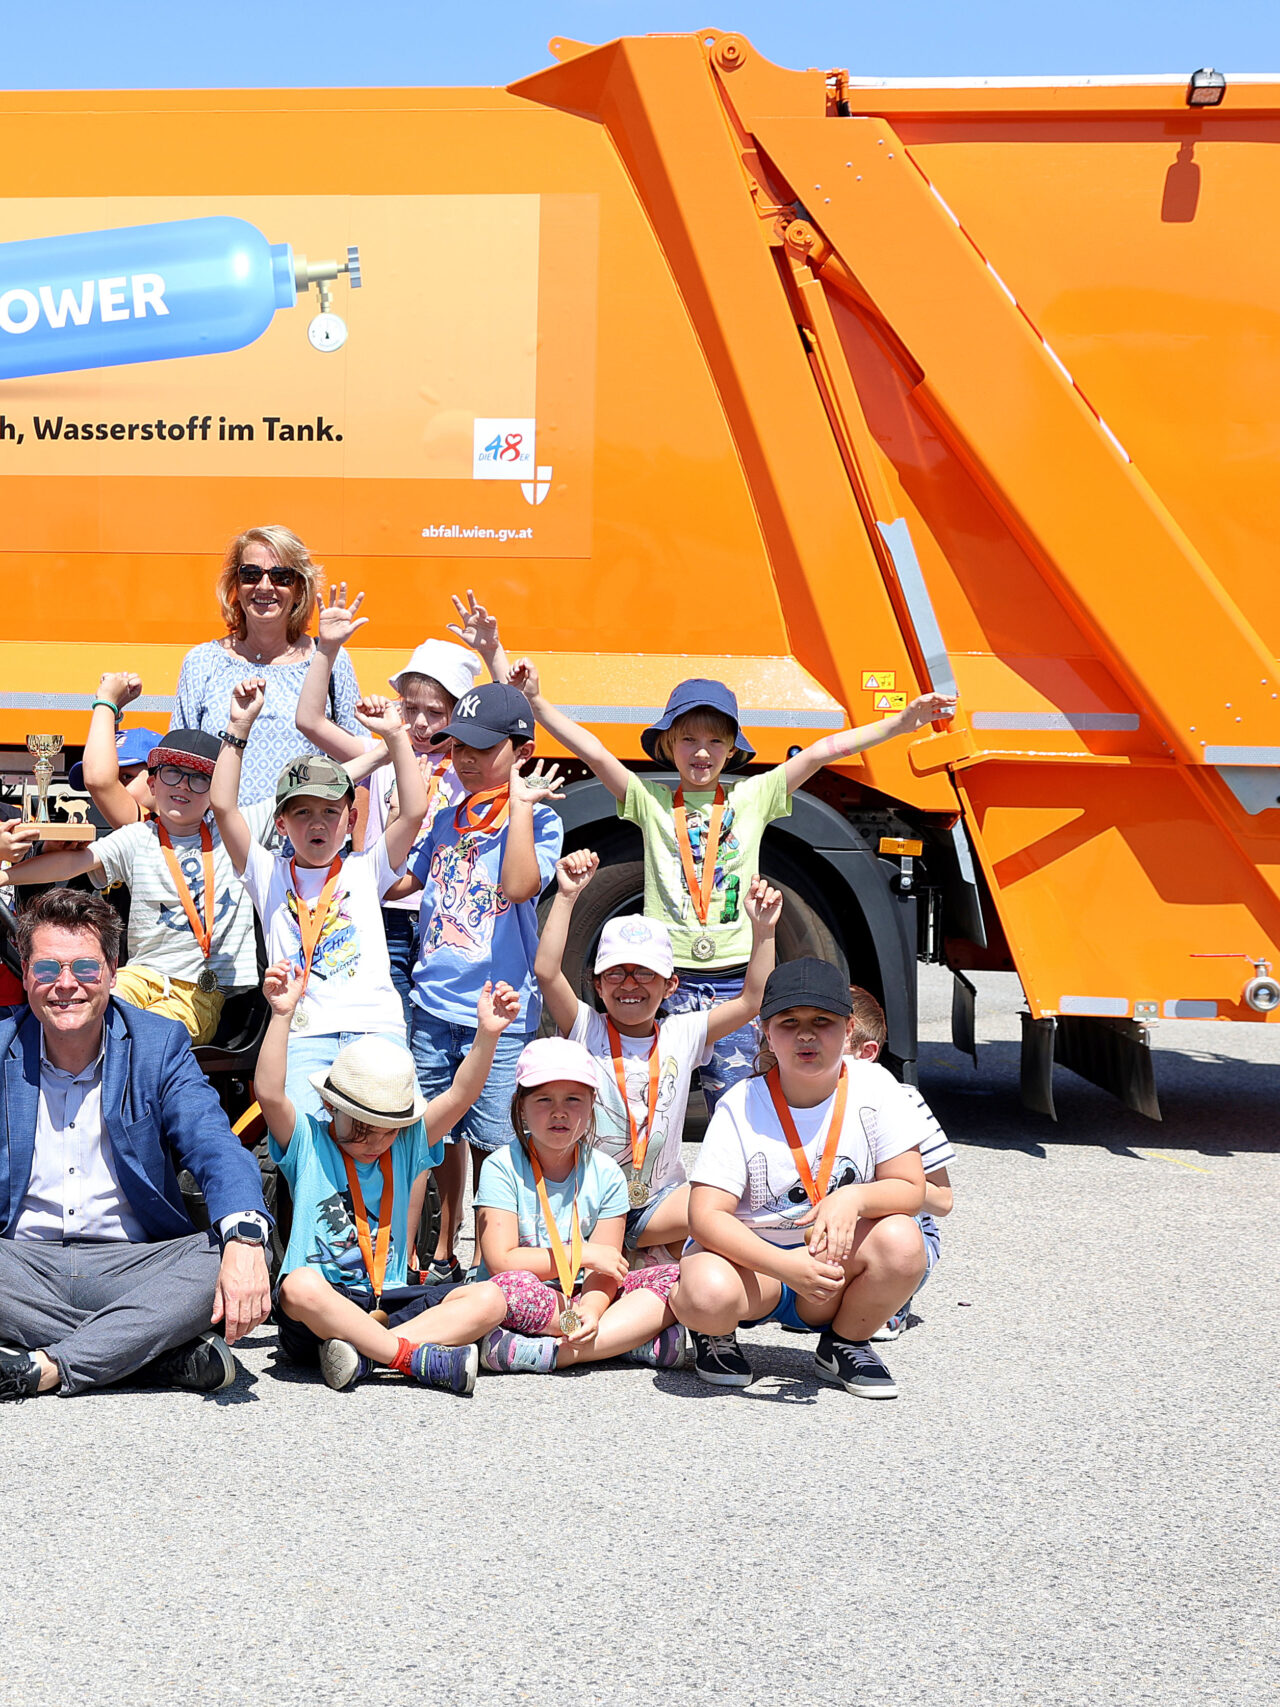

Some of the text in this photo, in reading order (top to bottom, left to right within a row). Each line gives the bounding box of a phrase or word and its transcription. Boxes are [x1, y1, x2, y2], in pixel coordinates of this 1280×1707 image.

[33, 415, 212, 441] Wasserstoff
[219, 416, 254, 441] im
[262, 416, 344, 442] Tank.
[421, 525, 533, 542] abfall.wien.gv.at
[456, 694, 482, 718] NY
[288, 764, 311, 788] NY
